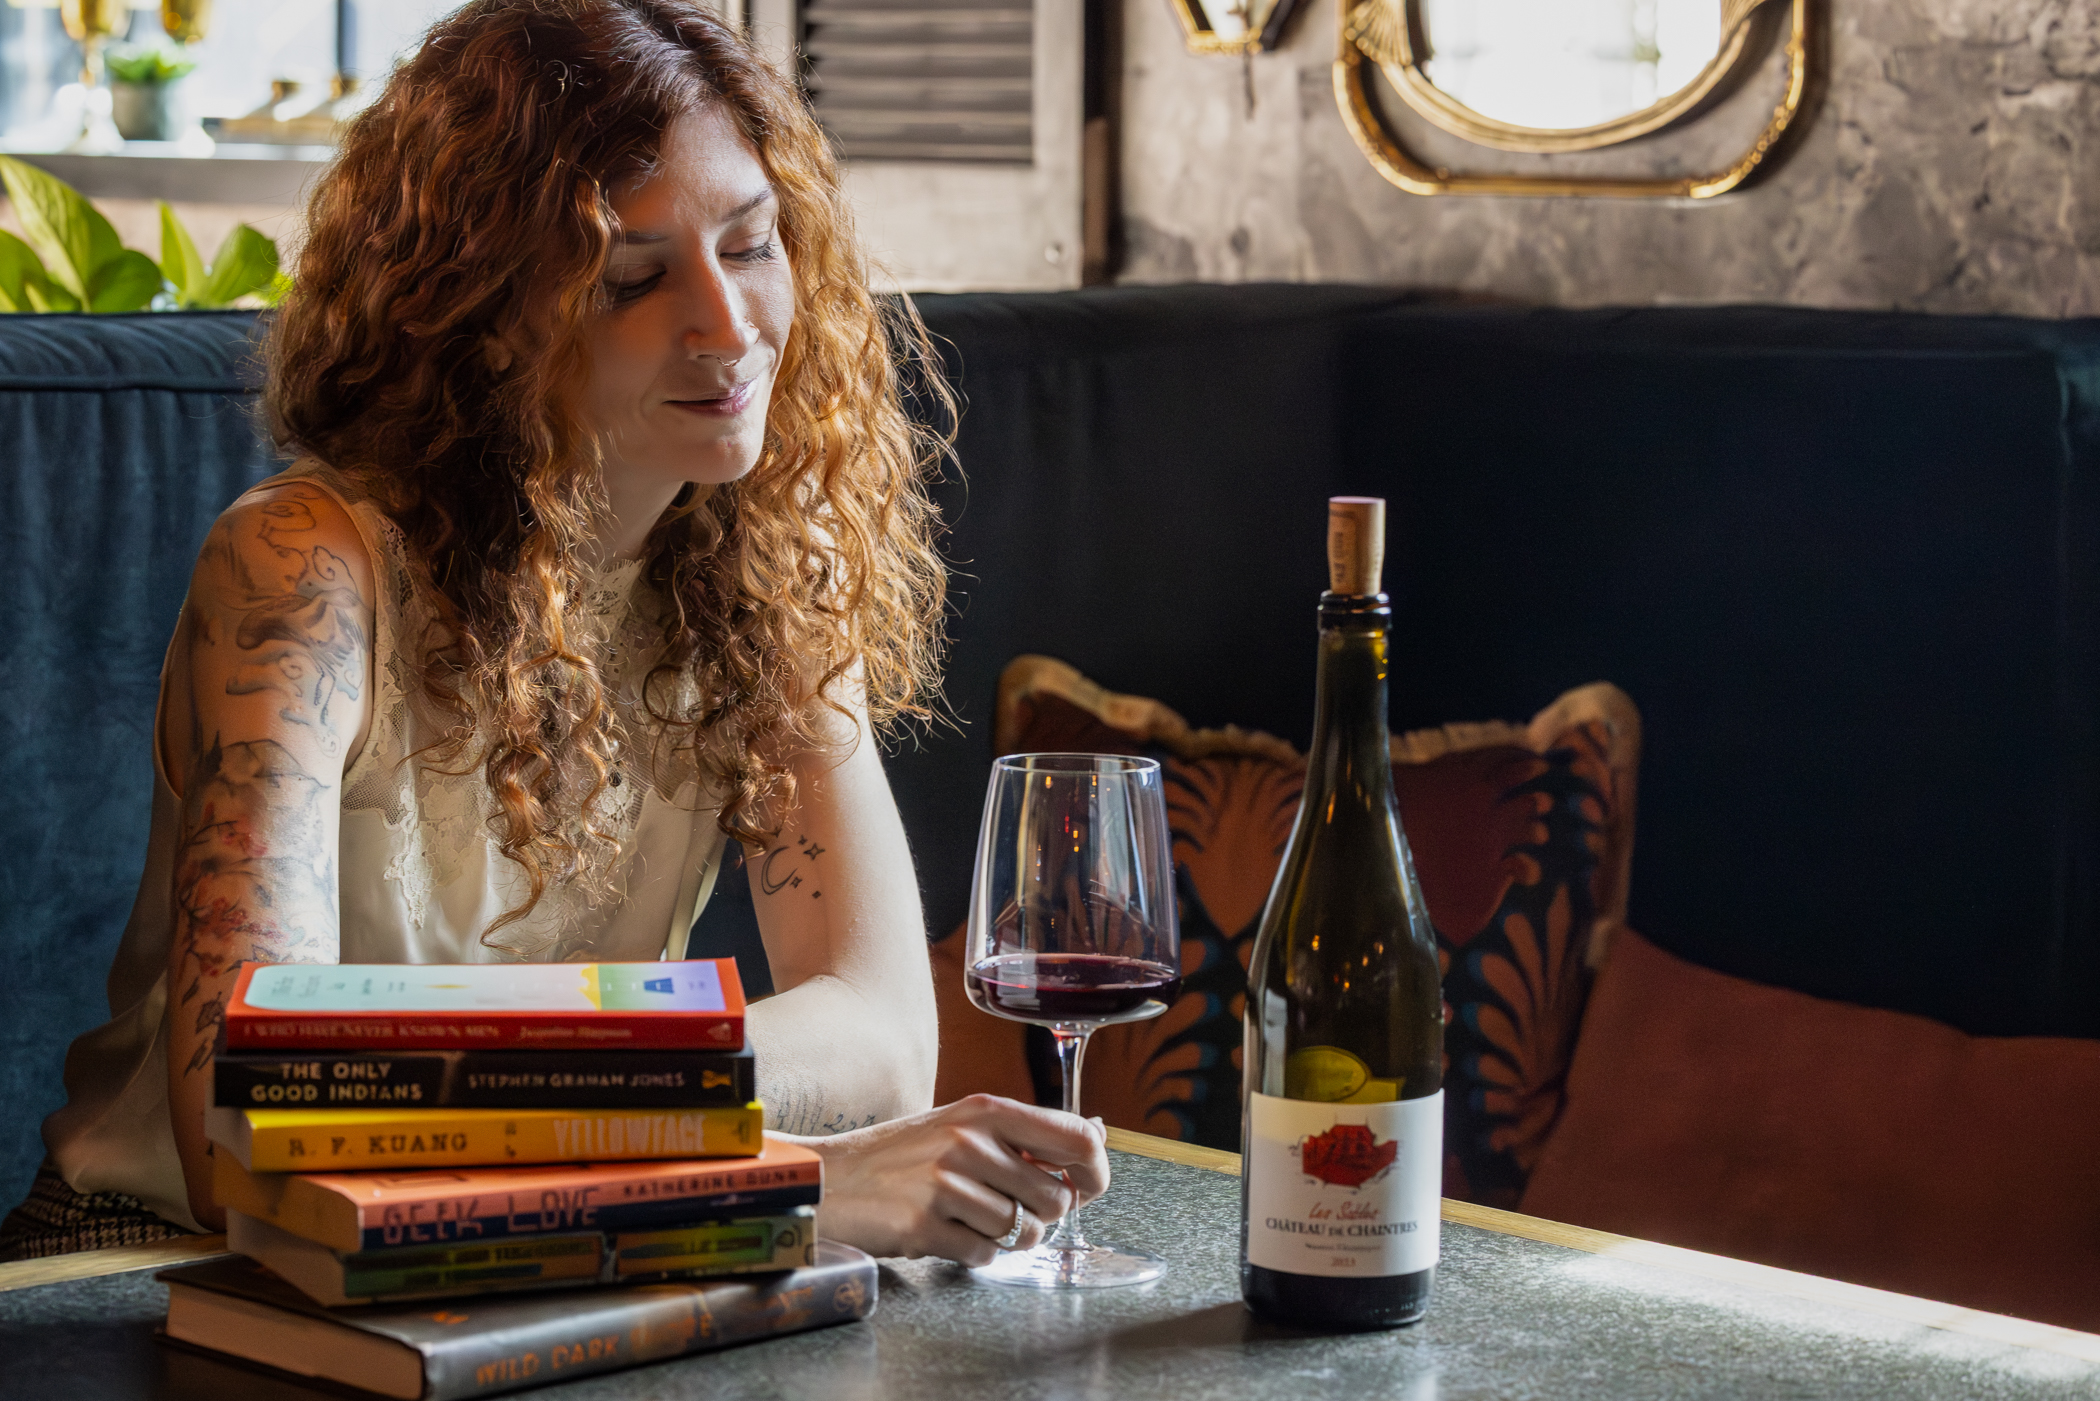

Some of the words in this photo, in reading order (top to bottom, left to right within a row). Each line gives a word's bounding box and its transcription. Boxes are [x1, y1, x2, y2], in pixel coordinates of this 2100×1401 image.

[282, 1062, 323, 1080] THE
[332, 1061, 392, 1079] ONLY
[468, 1074, 546, 1089] STEPHEN
[550, 1073, 625, 1088] GRAHAM
[629, 1071, 686, 1088] JONES
[250, 1084, 319, 1102] GOOD
[328, 1082, 423, 1102] INDIANS
[330, 1136, 353, 1156] F.
[368, 1132, 468, 1154] KUANG
[553, 1111, 708, 1157] YELLOWFACE
[622, 1172, 736, 1197] KATHERINE
[745, 1169, 799, 1186] DUNN
[382, 1197, 484, 1246] GEEK
[506, 1186, 600, 1233] LOVE
[1265, 1217, 1326, 1236] CHÂTEAU
[1347, 1219, 1419, 1237] CHAINTRES
[475, 1351, 541, 1387] WILD
[551, 1334, 621, 1371] DARK
